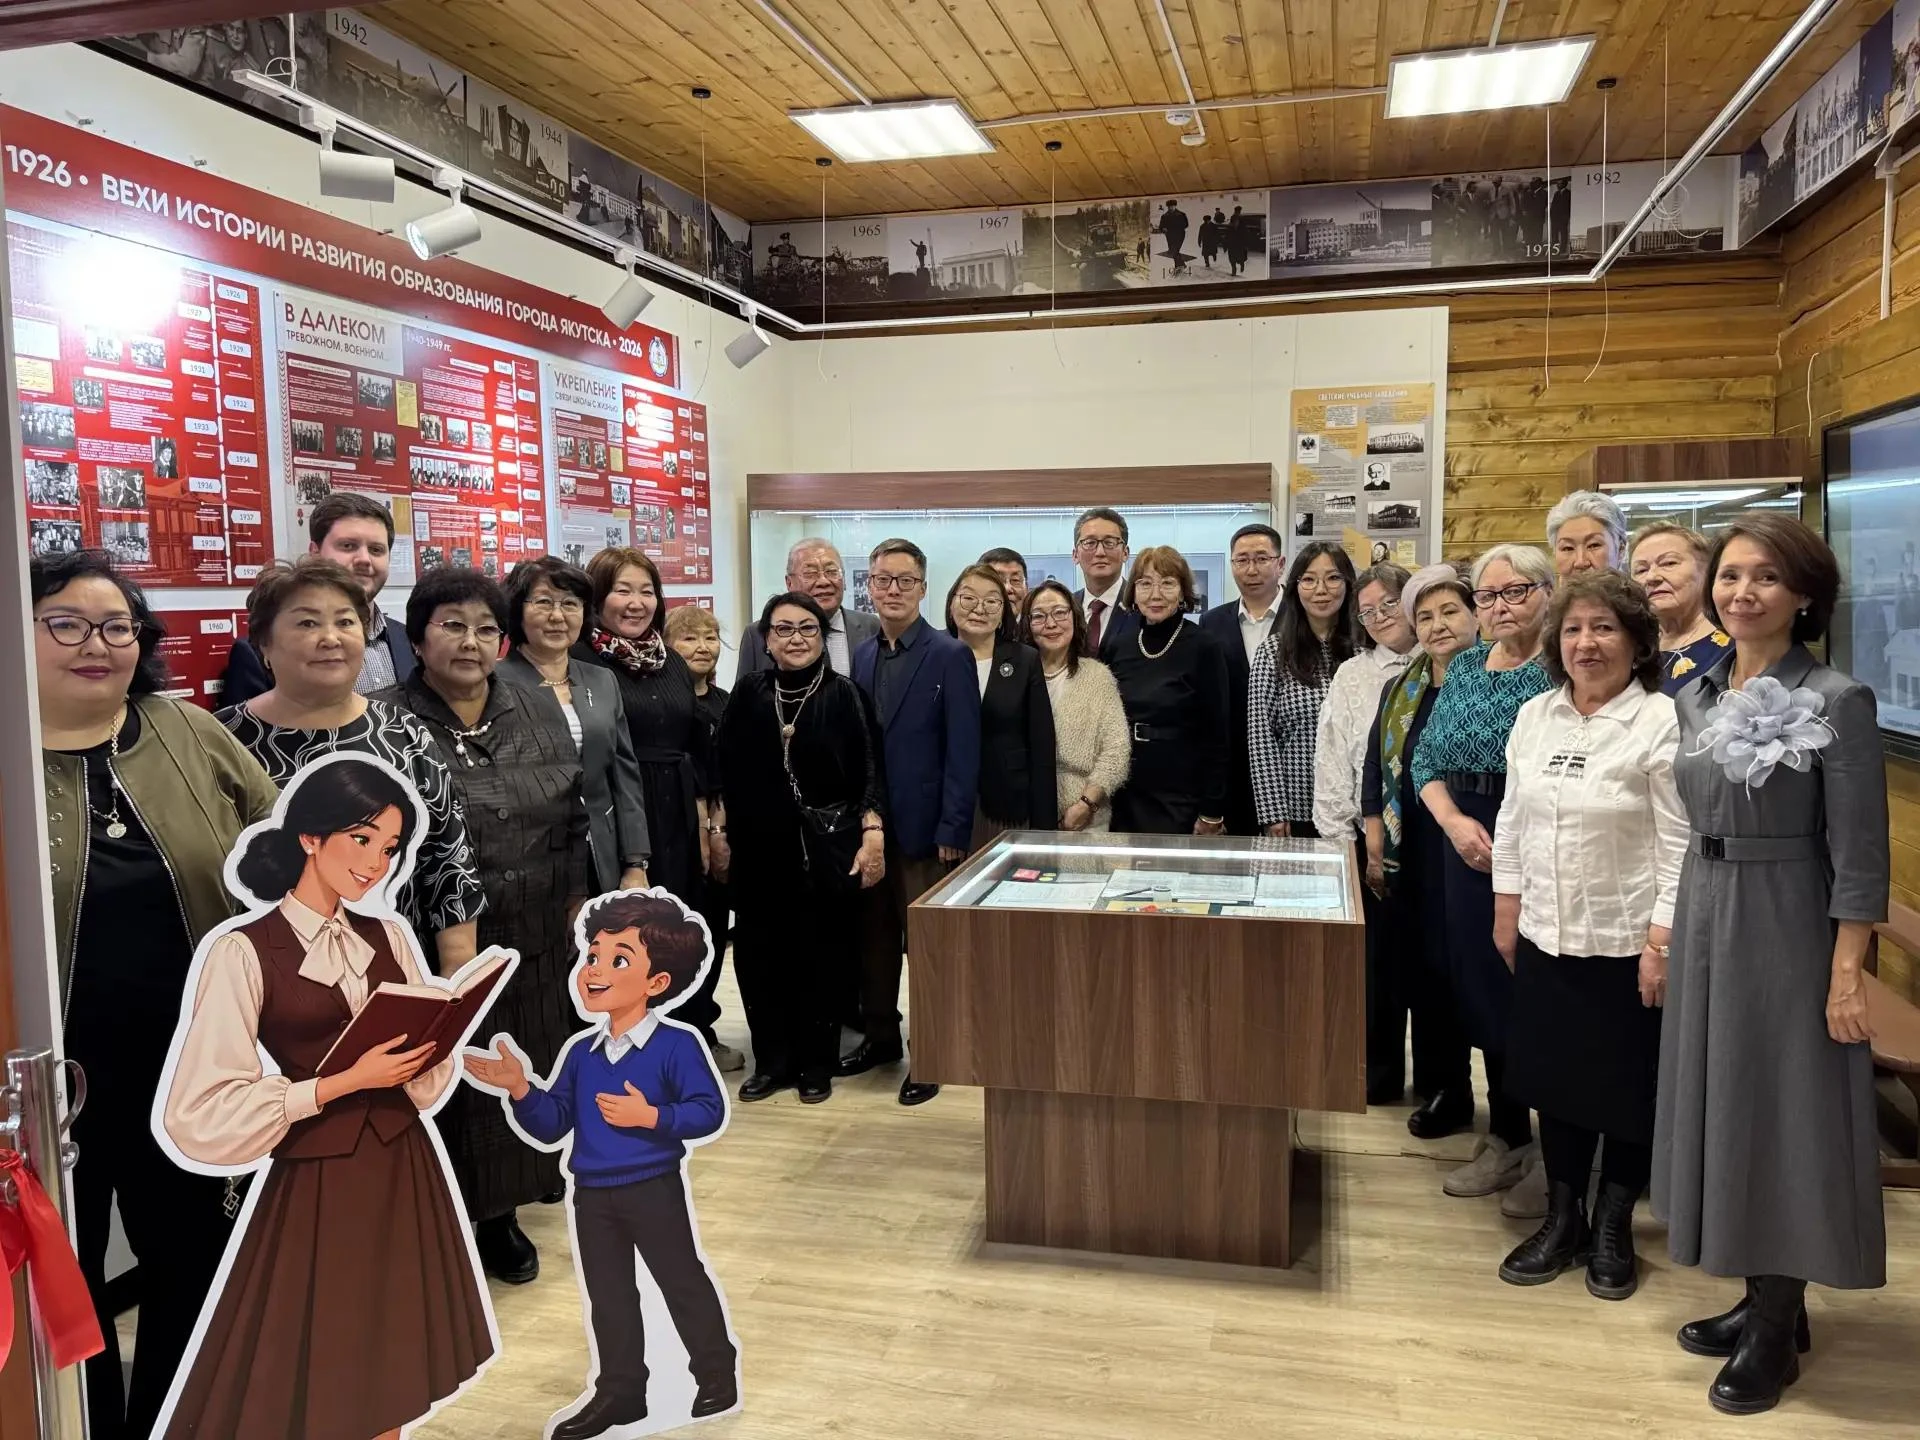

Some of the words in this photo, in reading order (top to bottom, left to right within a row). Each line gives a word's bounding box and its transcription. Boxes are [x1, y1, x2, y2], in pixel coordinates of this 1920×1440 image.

[334, 12, 368, 46] 1942
[540, 123, 563, 147] 1944
[1585, 171, 1621, 186] 1982
[852, 224, 881, 238] 1965
[979, 216, 1009, 230] 1967
[5, 144, 72, 188] 1926
[102, 173, 169, 217] ВЕХИ
[176, 196, 286, 252] ИСТОРИИ
[291, 232, 386, 282] РАЗВИТИЯ
[390, 265, 503, 317] ОБРАЗОВАНИЯ
[506, 300, 558, 333] ГОРОДА
[560, 320, 612, 349] ЯКУТСКА
[619, 335, 643, 358] 2026
[1526, 242, 1561, 257] 1975
[284, 302, 295, 323] В
[300, 307, 386, 345] ДАЛЕКОМ
[287, 329, 344, 353] ТРЕВОЖНОМ,
[554, 370, 617, 400] УКРЕПЛЕНИЕ
